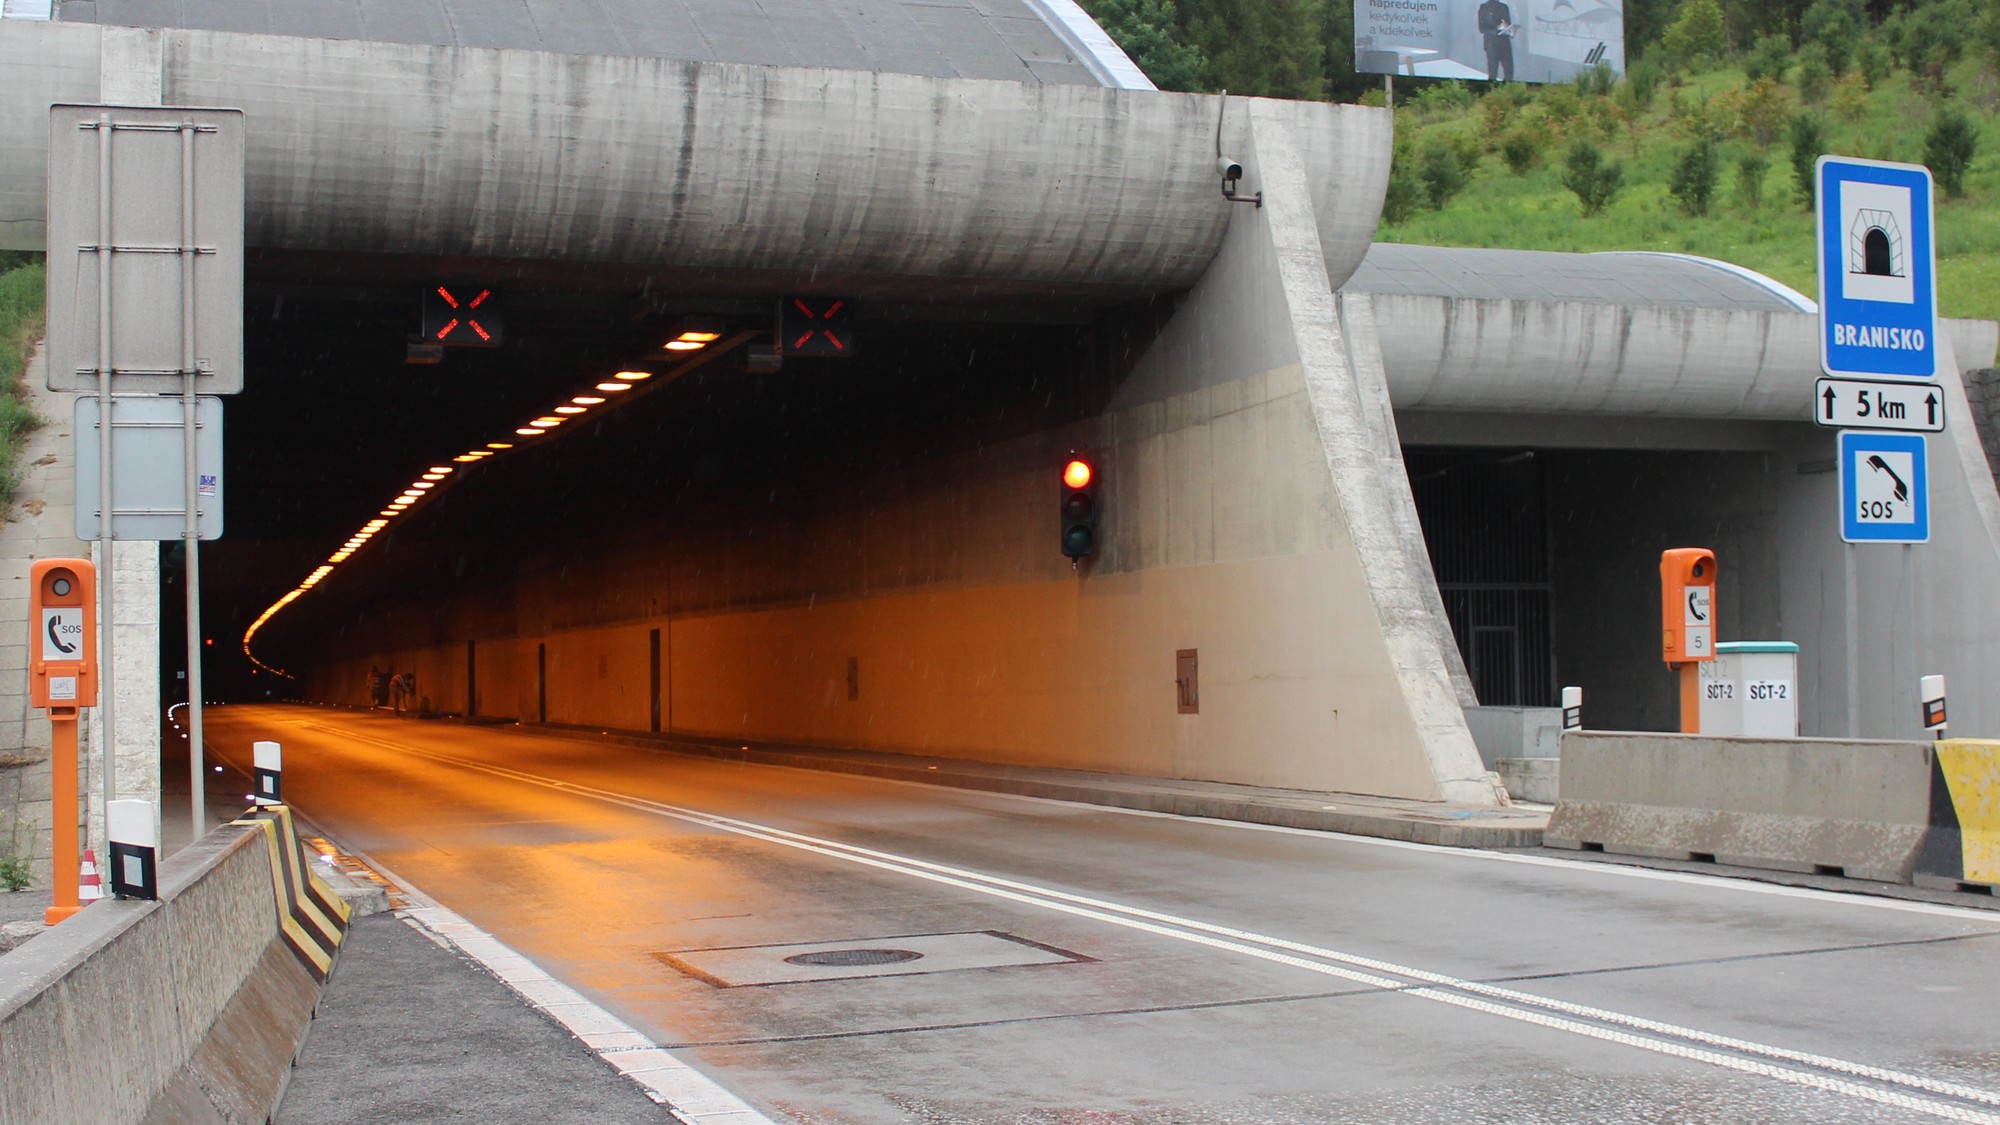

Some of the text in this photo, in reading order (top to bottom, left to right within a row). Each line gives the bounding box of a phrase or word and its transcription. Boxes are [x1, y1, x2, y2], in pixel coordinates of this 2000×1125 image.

[1369, 0, 1437, 12] napredujem
[1369, 26, 1376, 35] a
[1834, 323, 1925, 351] BRANISKO
[1857, 390, 1905, 419] 5 km
[1861, 501, 1893, 519] SOS
[62, 625, 82, 634] SOS
[1695, 636, 1702, 648] 5
[1707, 680, 1733, 699] SČT-2
[1750, 680, 1786, 699] SČT-2
